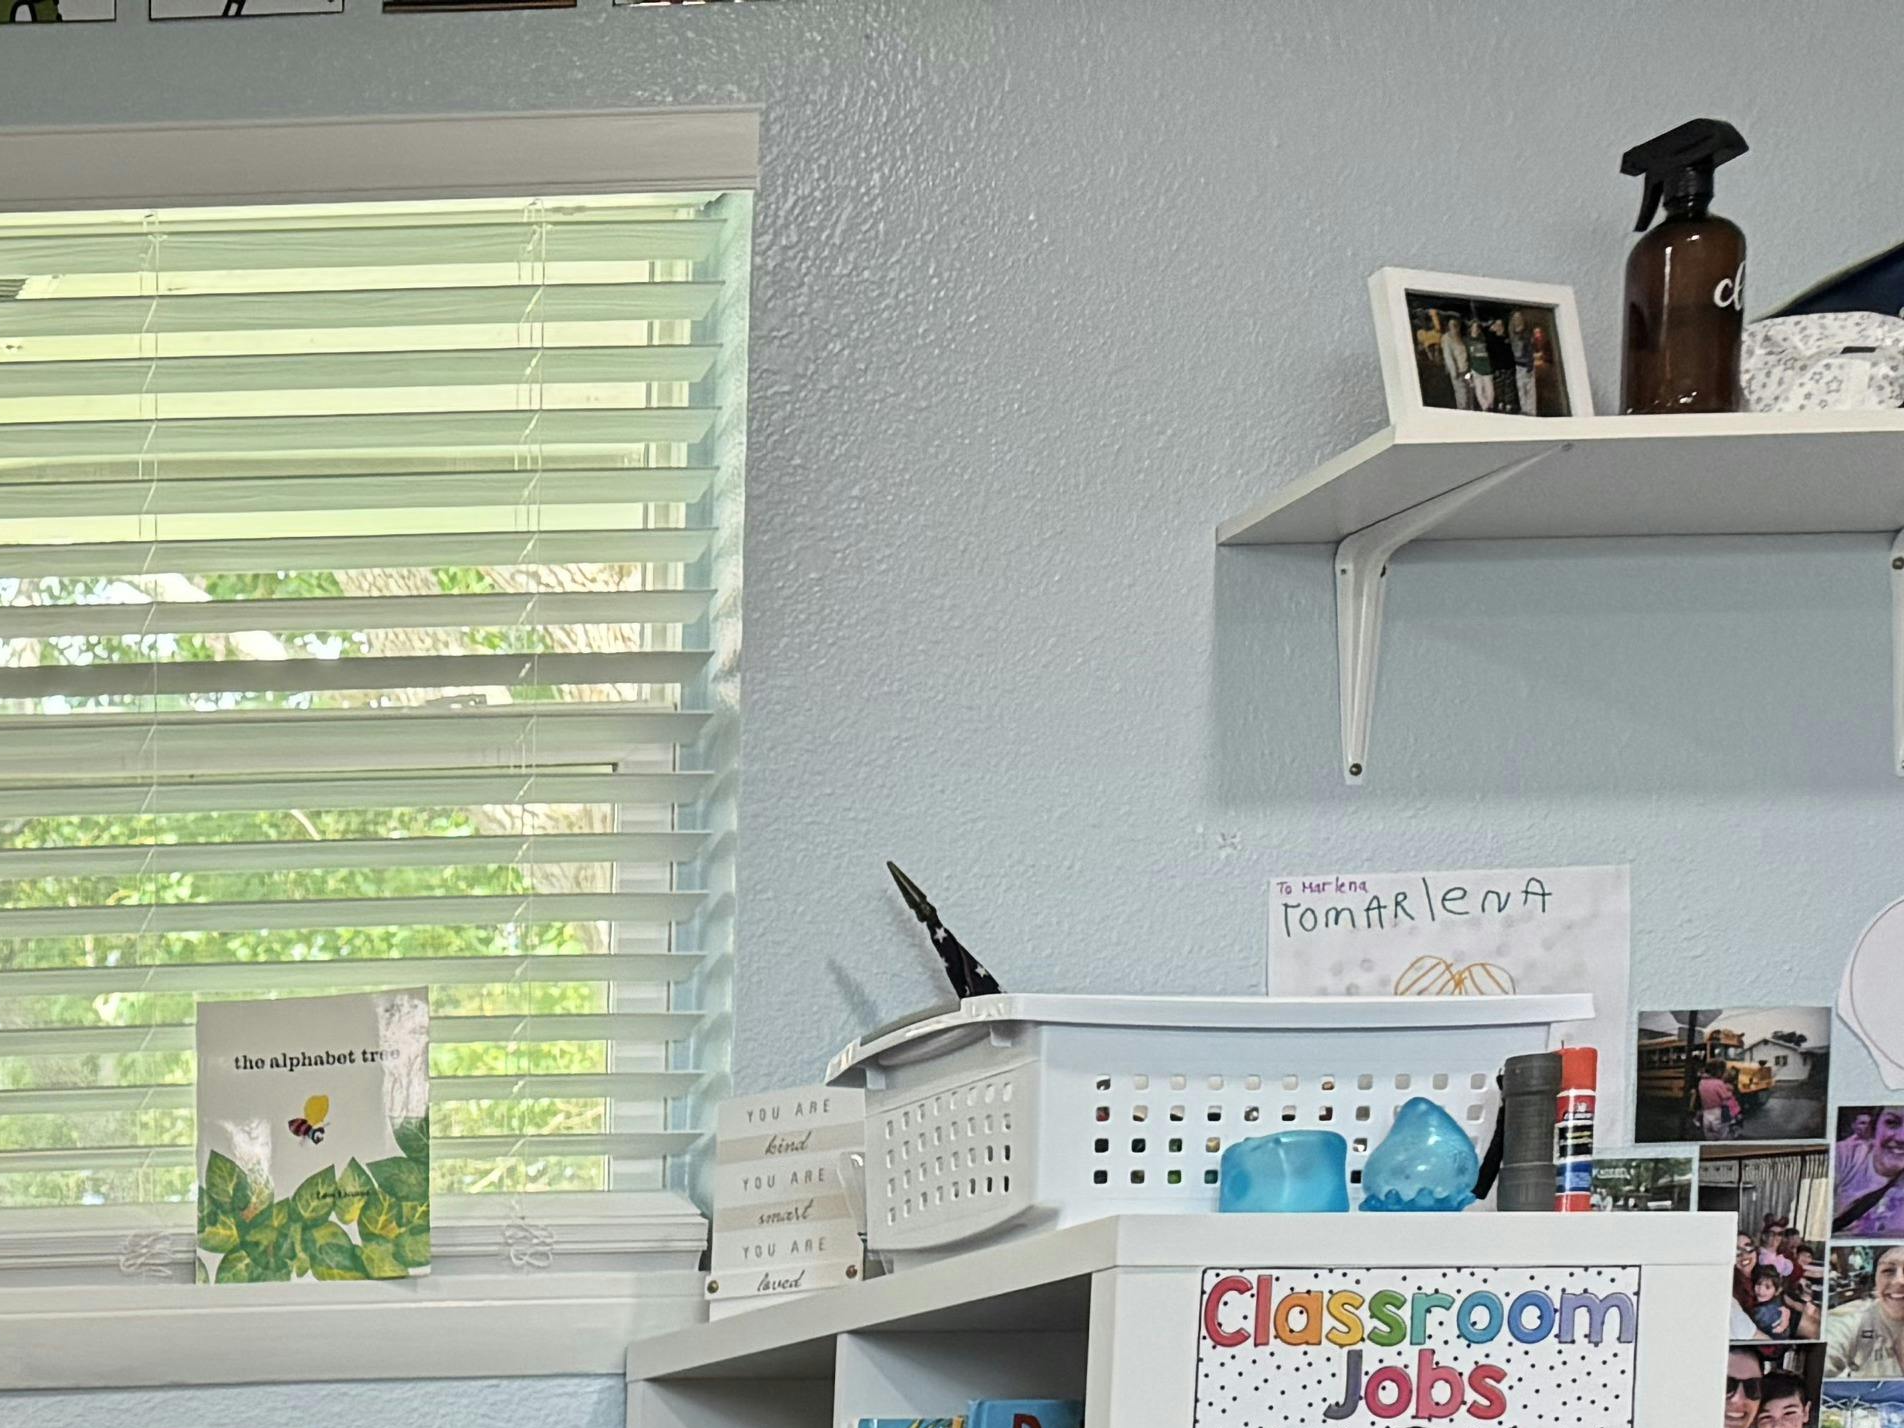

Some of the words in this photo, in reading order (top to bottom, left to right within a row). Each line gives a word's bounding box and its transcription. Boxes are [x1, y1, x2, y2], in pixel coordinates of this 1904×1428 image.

[1277, 882, 1292, 895] To
[1302, 876, 1369, 893] Marlena
[235, 1055, 265, 1070] the
[270, 1050, 356, 1071] alphabet
[362, 1048, 401, 1063] tree
[747, 1107, 780, 1123] YOU
[795, 1099, 830, 1116] ARE
[765, 1131, 812, 1155] kind
[743, 1176, 776, 1191] YOU
[791, 1168, 825, 1184] ARE
[759, 1198, 814, 1224] smart
[743, 1244, 776, 1259] YOU
[791, 1237, 825, 1253] ARE
[757, 1269, 805, 1292] loved
[1204, 1274, 1634, 1347] Classroom
[1323, 1348, 1508, 1420] Jobs
